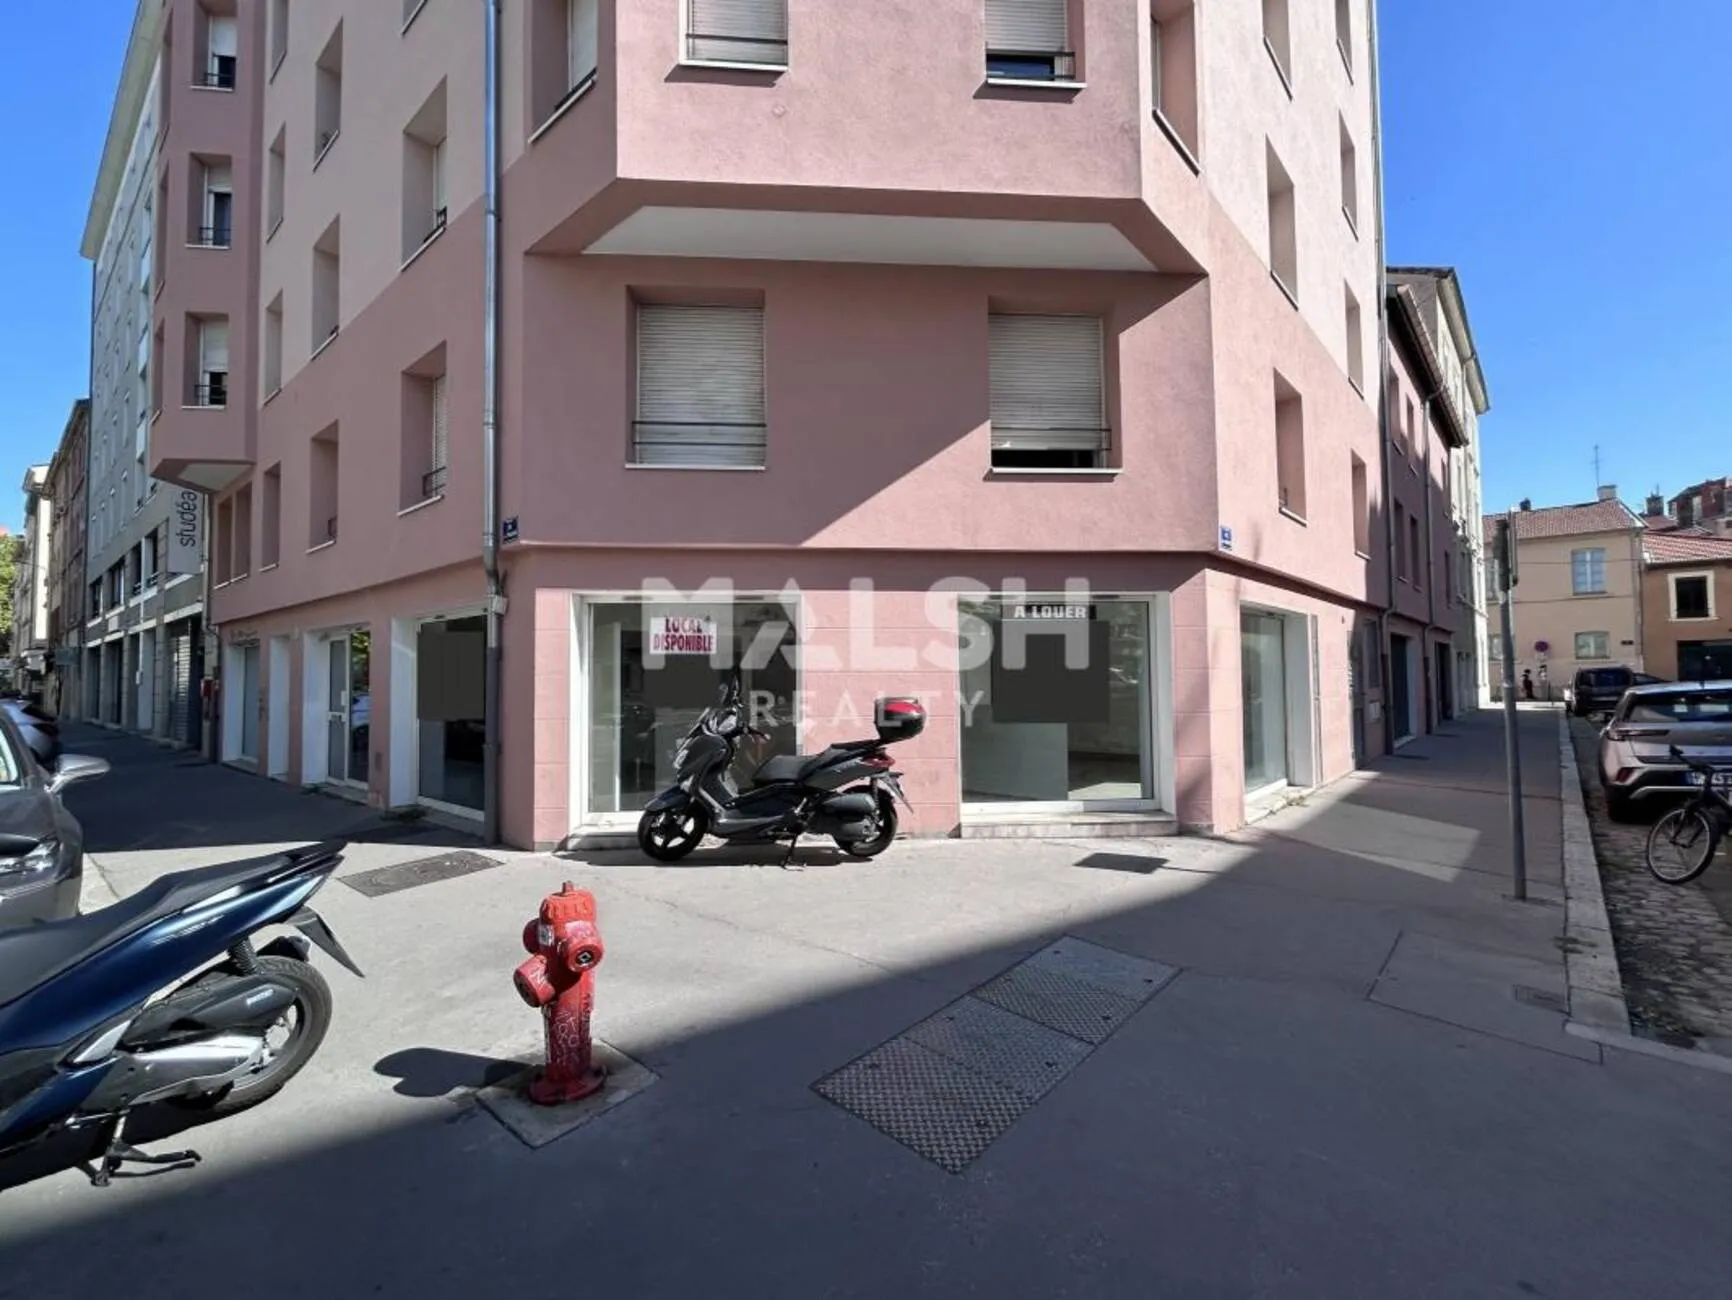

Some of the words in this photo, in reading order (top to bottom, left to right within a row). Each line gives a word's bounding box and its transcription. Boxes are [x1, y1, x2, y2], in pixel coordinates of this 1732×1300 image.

[1014, 605, 1026, 619] A
[1031, 605, 1087, 619] LOUER
[665, 617, 703, 633] LOCAL
[653, 633, 712, 652] DISPONIBLE
